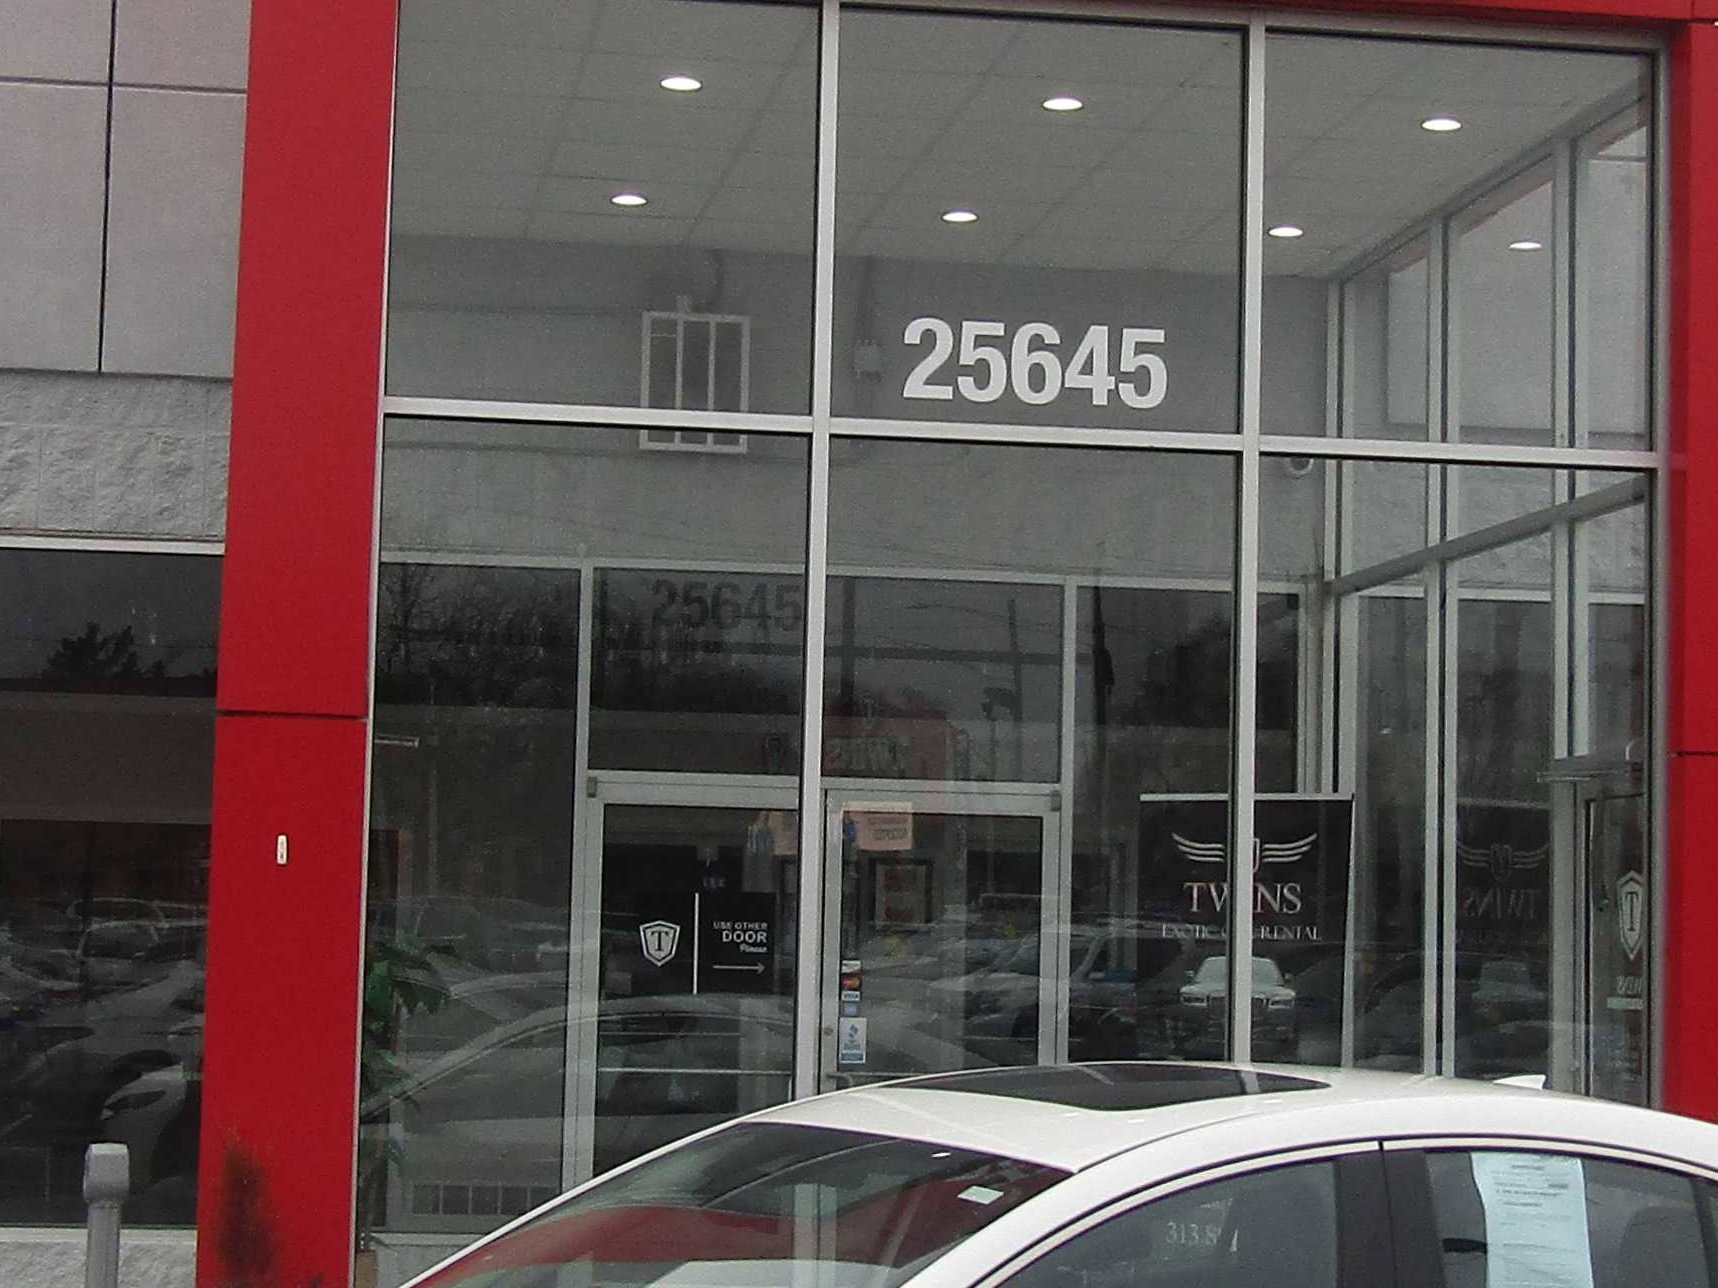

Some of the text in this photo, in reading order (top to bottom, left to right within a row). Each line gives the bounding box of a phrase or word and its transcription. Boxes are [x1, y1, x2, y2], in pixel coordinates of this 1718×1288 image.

[902, 317, 1169, 410] 25645
[1184, 882, 1303, 914] TWNS
[713, 921, 768, 930] USE OTHER
[1260, 924, 1323, 941] RENTAL
[722, 930, 768, 943] DOOR
